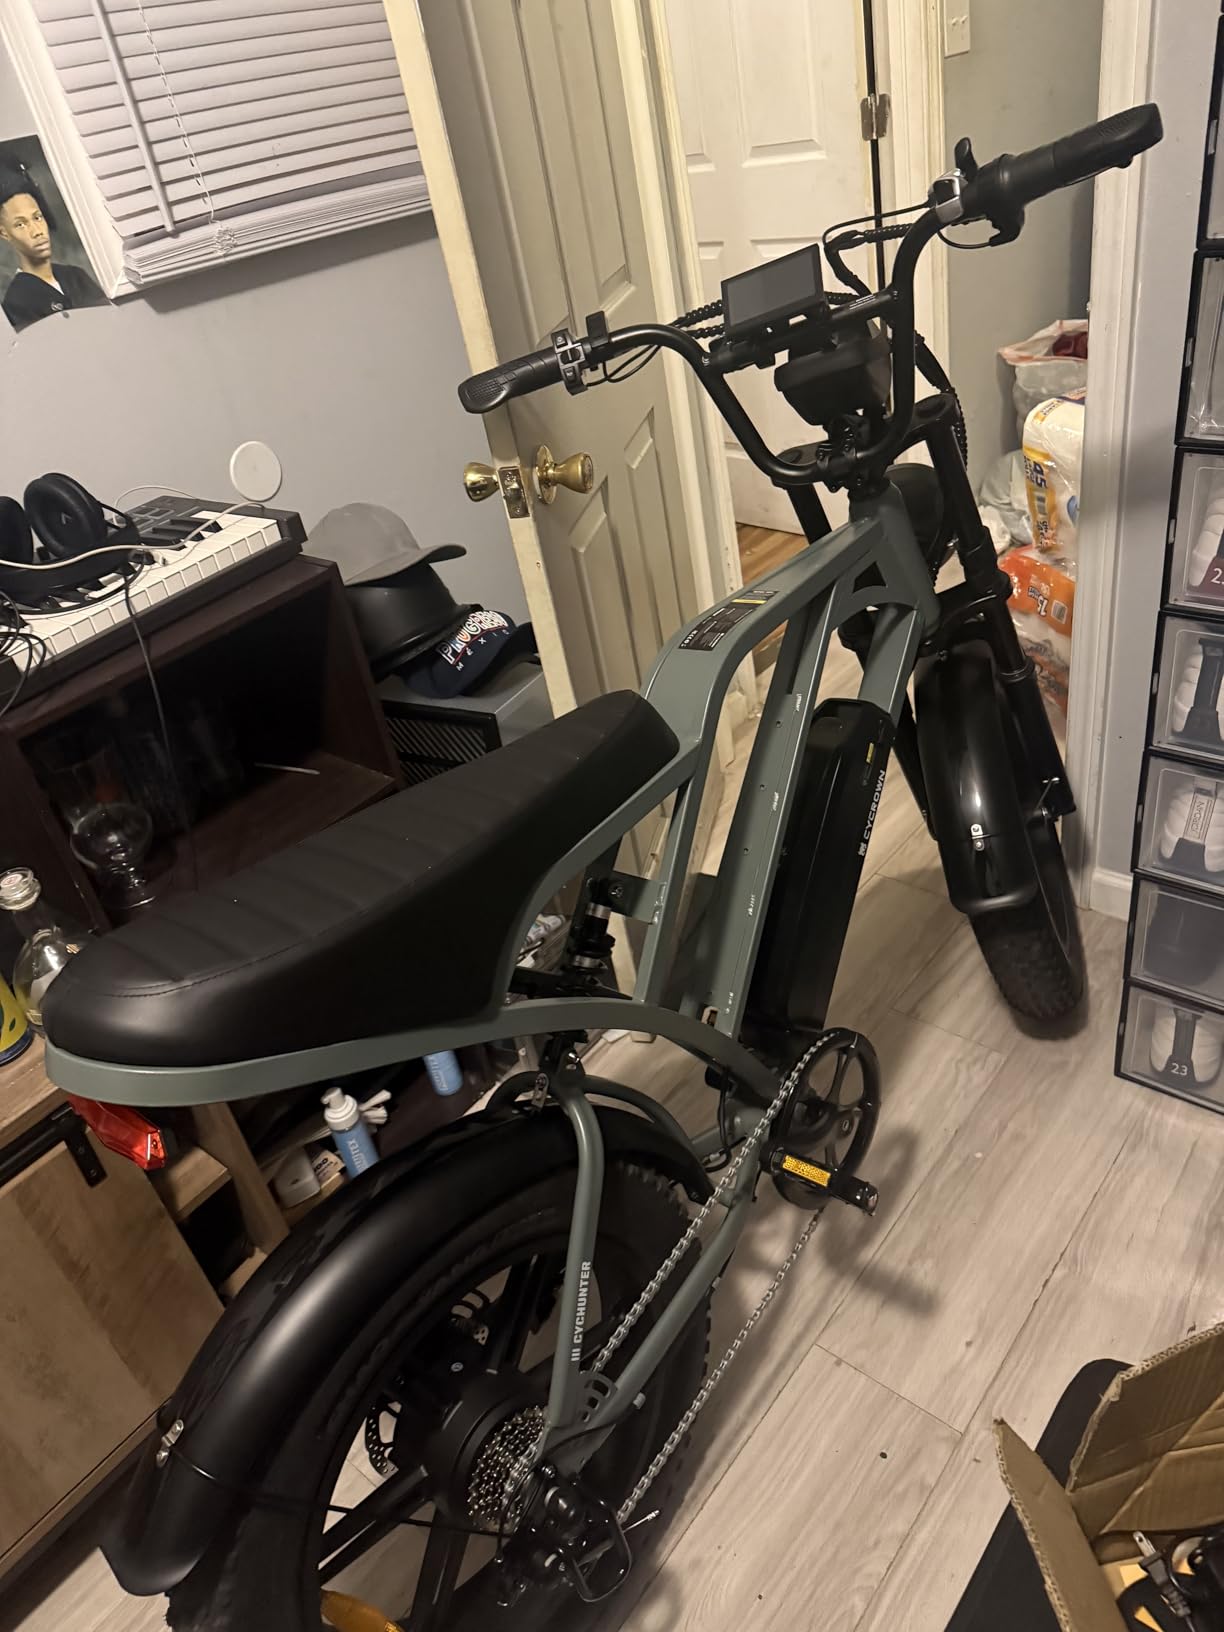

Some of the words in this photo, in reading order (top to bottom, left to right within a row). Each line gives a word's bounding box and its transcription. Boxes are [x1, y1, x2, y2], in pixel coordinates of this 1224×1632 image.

[1211, 567, 1224, 584] 2
[863, 769, 886, 841] CYCROWN
[1171, 1062, 1188, 1076] 23
[573, 1260, 592, 1344] CYCHUNTER
